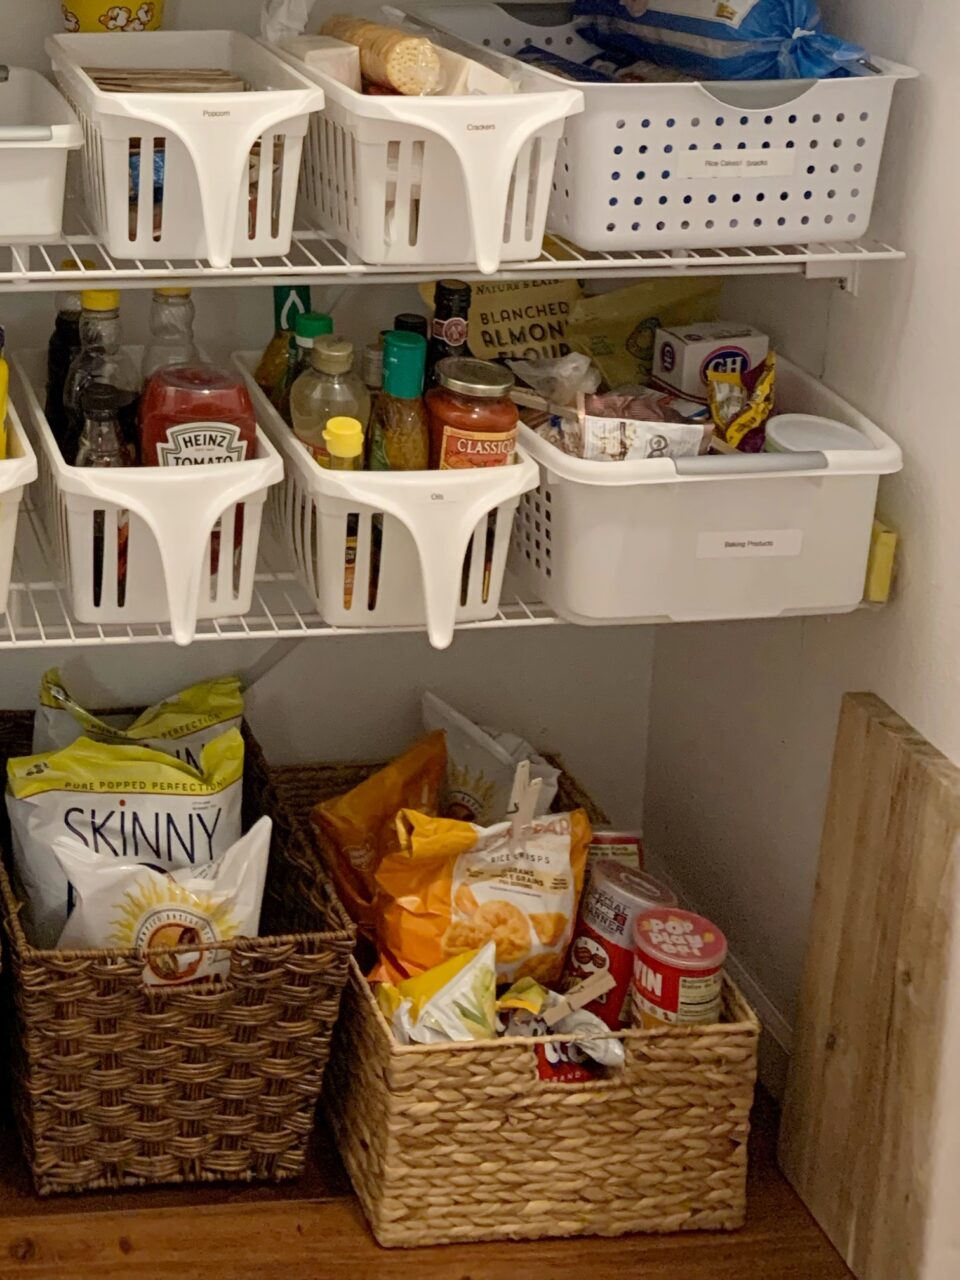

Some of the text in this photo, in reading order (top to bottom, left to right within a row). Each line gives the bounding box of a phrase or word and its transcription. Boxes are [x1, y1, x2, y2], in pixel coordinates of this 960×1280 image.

[467, 123, 496, 131] Crackers
[476, 280, 530, 295] NATURE'S
[480, 302, 570, 325] BLANCHED
[481, 319, 570, 348] ALMON
[182, 434, 227, 448] HEINZ
[65, 778, 224, 792] PURE POPPED PERFECTION
[64, 799, 222, 864] SKINNY
[491, 853, 510, 864] RICE
